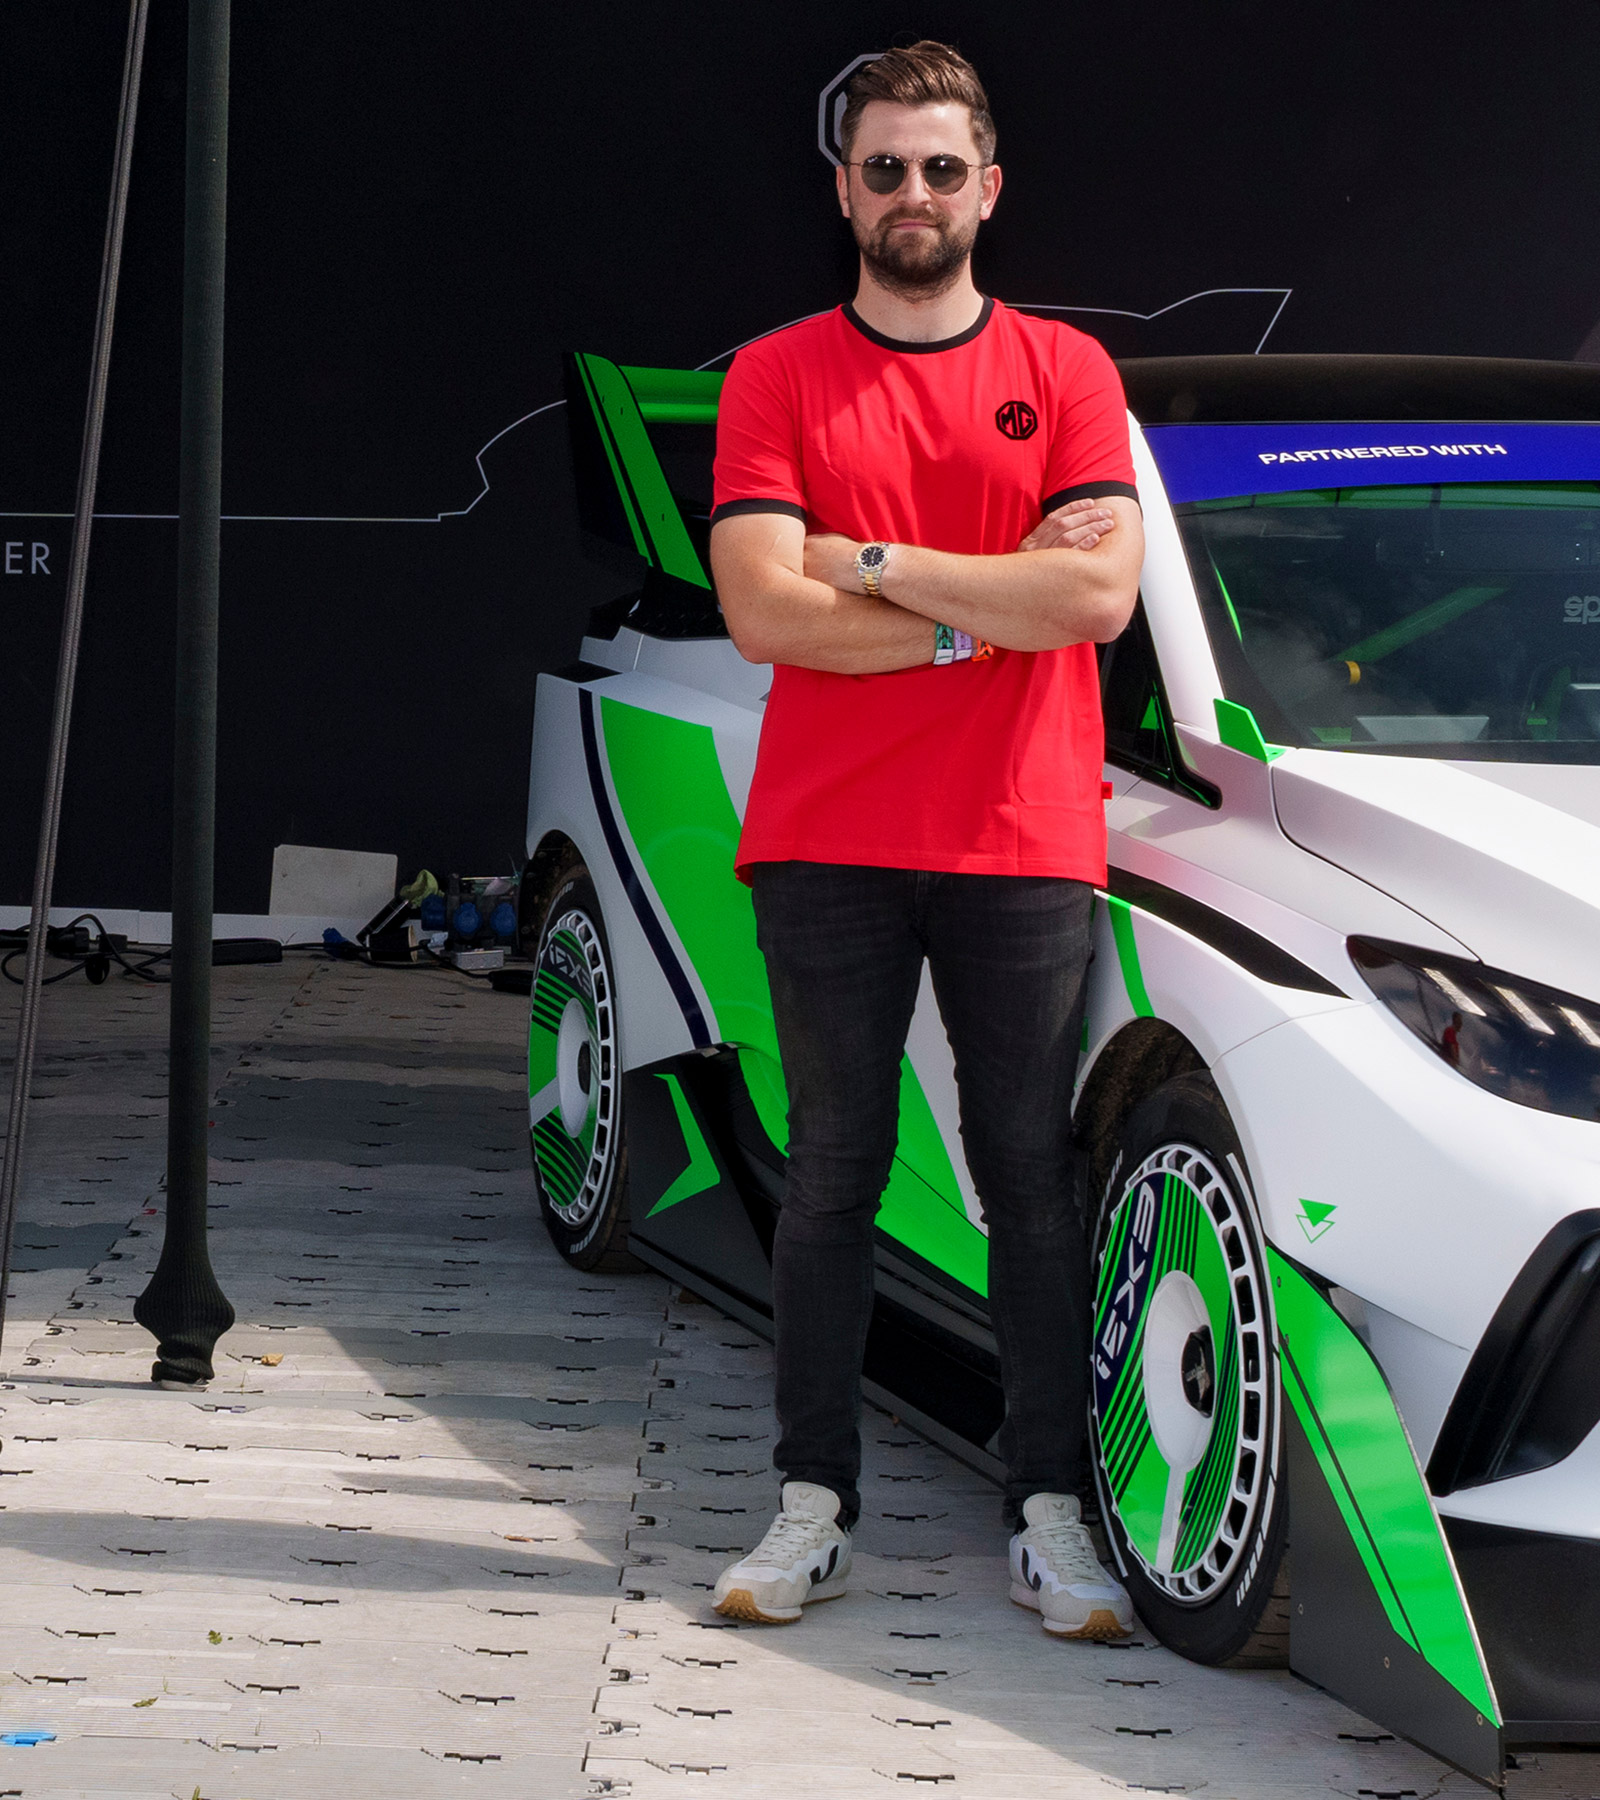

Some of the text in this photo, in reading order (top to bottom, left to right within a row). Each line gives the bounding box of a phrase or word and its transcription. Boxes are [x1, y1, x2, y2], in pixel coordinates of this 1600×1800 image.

[1000, 403, 1034, 437] MG
[1258, 444, 1508, 465] PARTNERED WITH
